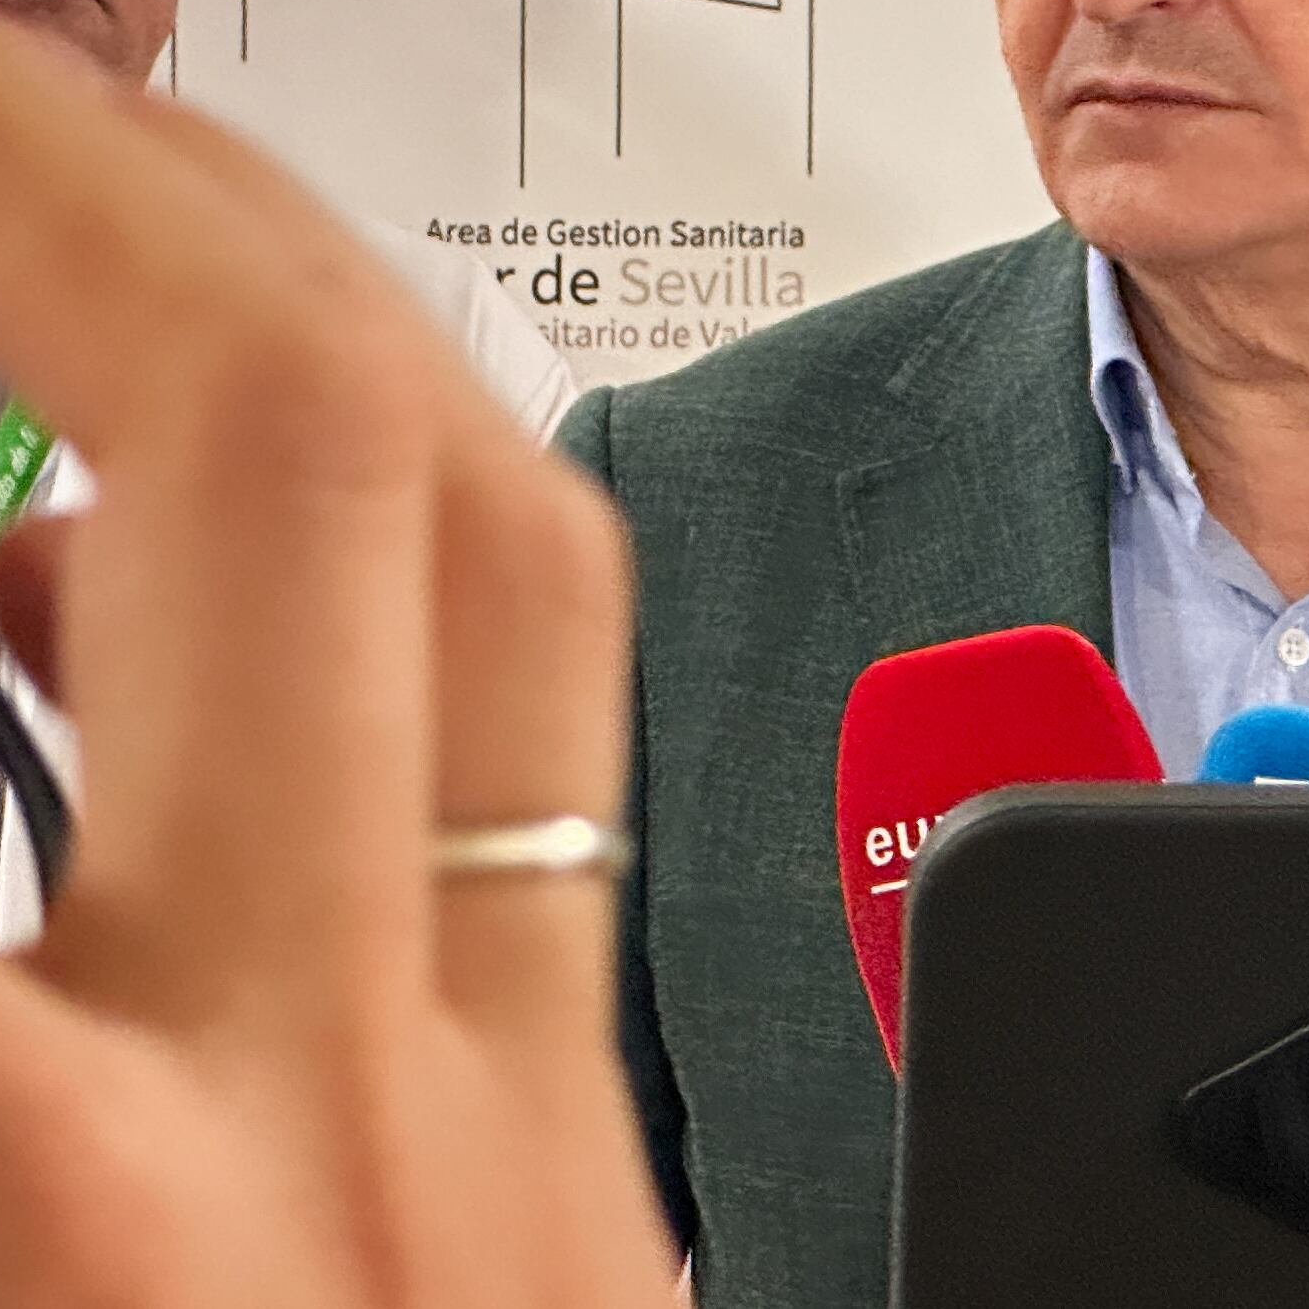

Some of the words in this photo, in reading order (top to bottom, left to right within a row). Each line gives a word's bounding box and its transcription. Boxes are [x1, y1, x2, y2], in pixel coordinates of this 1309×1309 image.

[426, 218, 491, 244] Area
[501, 217, 537, 246] de
[547, 219, 660, 247] Gestion
[670, 220, 805, 248] Sanitaria
[532, 253, 599, 305] de
[619, 256, 805, 307] Sevilla
[649, 317, 690, 349] de
[865, 815, 944, 867] eu
